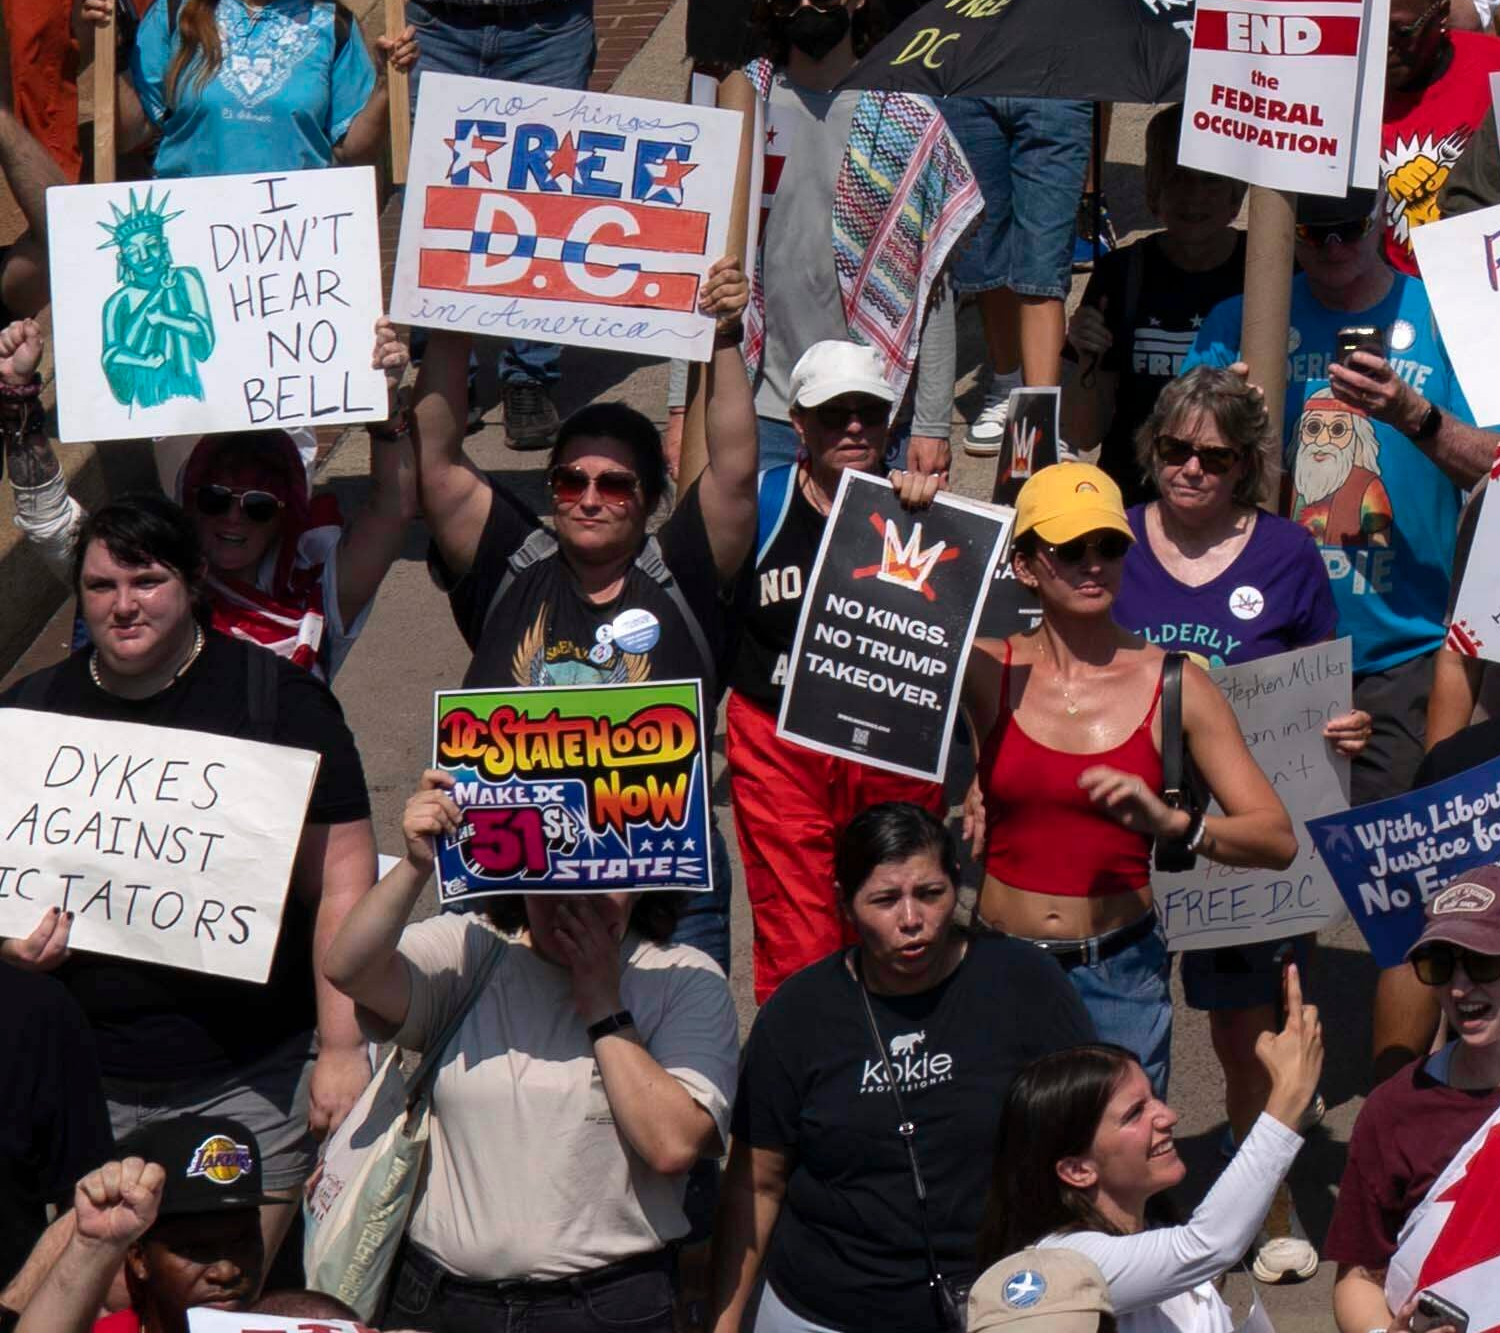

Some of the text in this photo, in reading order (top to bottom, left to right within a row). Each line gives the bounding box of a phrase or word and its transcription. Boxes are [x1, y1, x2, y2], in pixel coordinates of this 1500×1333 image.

[212, 214, 354, 271] DIDN'T
[232, 271, 349, 318] HEAR
[245, 374, 373, 422] BELL
